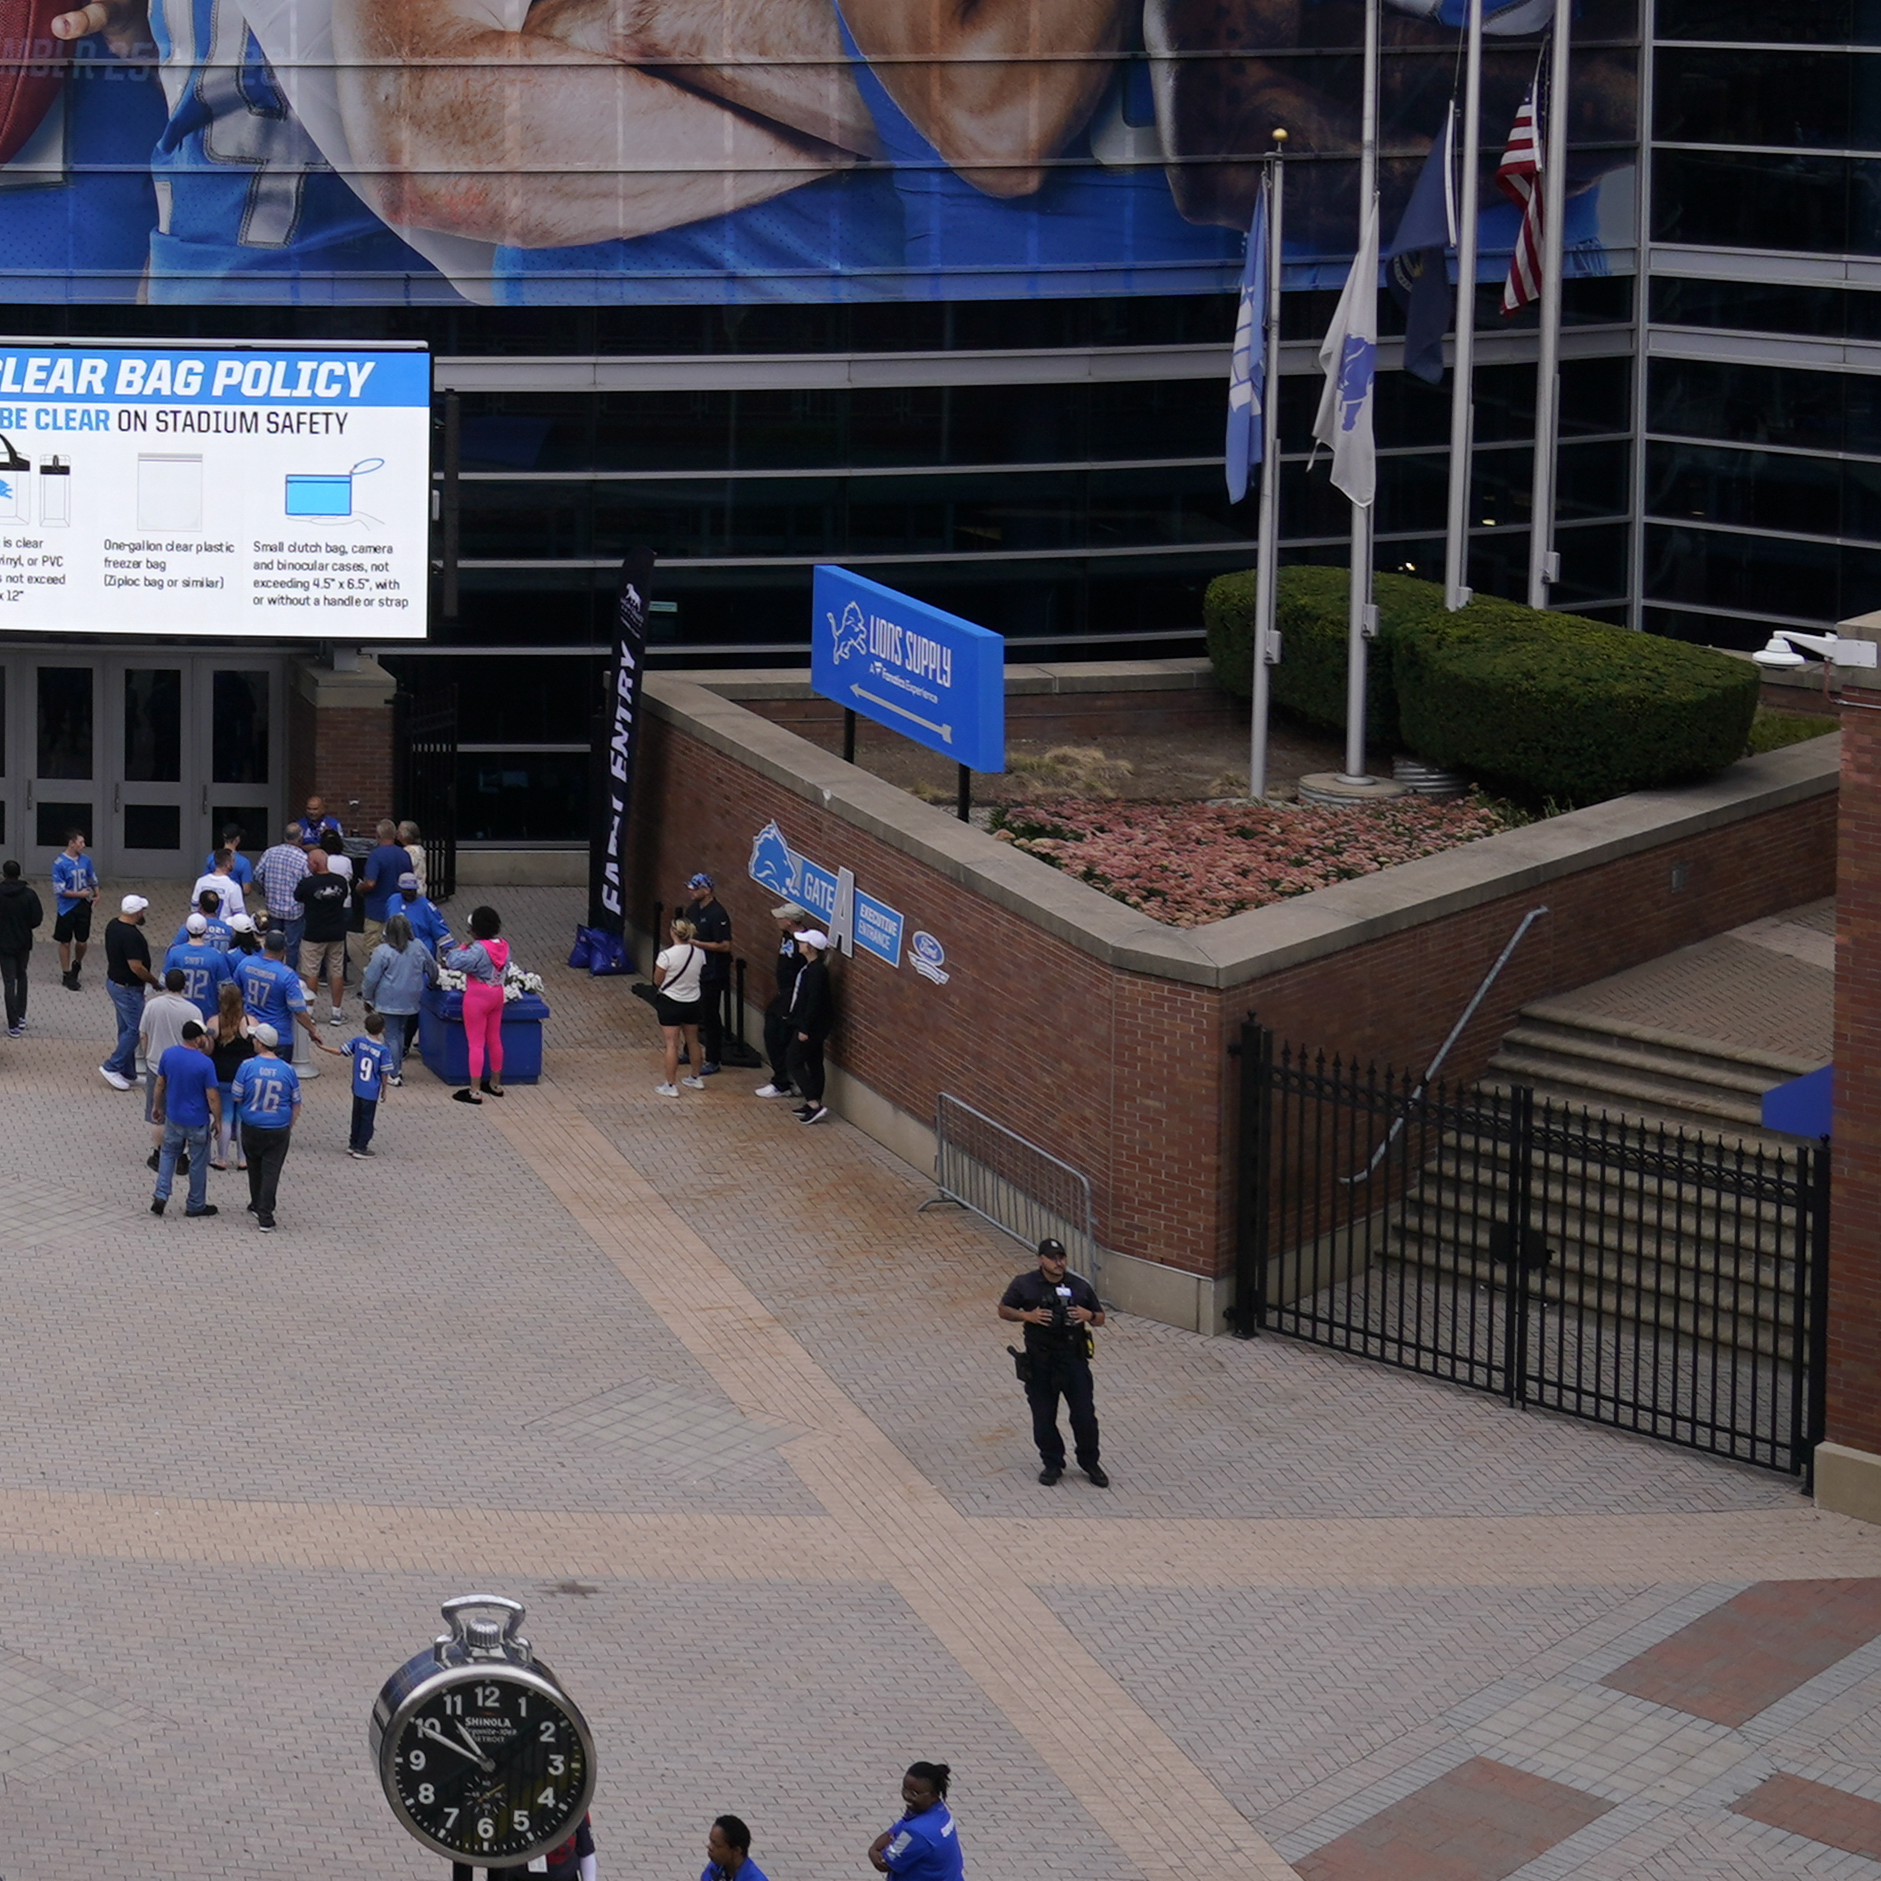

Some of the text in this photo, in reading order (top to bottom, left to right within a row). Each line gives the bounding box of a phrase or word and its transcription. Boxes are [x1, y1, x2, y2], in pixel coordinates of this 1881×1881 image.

[114, 359, 205, 396] BAG
[210, 360, 376, 398] POLICY
[35, 408, 110, 431] CLEAR
[118, 410, 147, 432] ON
[155, 410, 258, 434] STADIUM
[266, 412, 348, 435] SAFETY
[3, 536, 12, 548] is
[15, 537, 44, 549] clear
[104, 539, 235, 554] One-gallon clear plastic
[253, 541, 393, 556] Small clutch bag, camera
[27, 557, 39, 567] or
[42, 555, 64, 567] PVC
[104, 557, 166, 572] freezer bag
[253, 559, 390, 573] and binocular cases, not
[5, 574, 24, 584] not
[27, 574, 66, 585] exceed
[104, 574, 224, 590] (Ziploc bag or similar)
[253, 578, 310, 591] exceeding
[338, 581, 345, 589] x
[375, 579, 400, 590] with
[253, 595, 409, 610] or without a handle or strap
[869, 615, 952, 688] LIONS SUPPLY
[610, 640, 636, 783] ENTRY
[804, 872, 834, 915] GATE
[827, 866, 855, 958] A
[860, 903, 898, 936] EXECUTIVE
[858, 921, 892, 951] ENTRANCE
[247, 979, 271, 1007] 97
[359, 1057, 373, 1081] 9
[249, 1079, 283, 1113] 16
[443, 1695, 462, 1716] 11
[474, 1686, 500, 1708] 12
[518, 1697, 527, 1717] 1
[464, 1717, 512, 1728] SHINOLA
[540, 1722, 555, 1742] 2
[409, 1750, 426, 1770] 9
[547, 1754, 565, 1775] 3
[418, 1783, 435, 1804] 8
[537, 1787, 555, 1808] 4
[443, 1808, 460, 1828] 7
[477, 1818, 494, 1838] 6
[513, 1810, 529, 1831] 5
